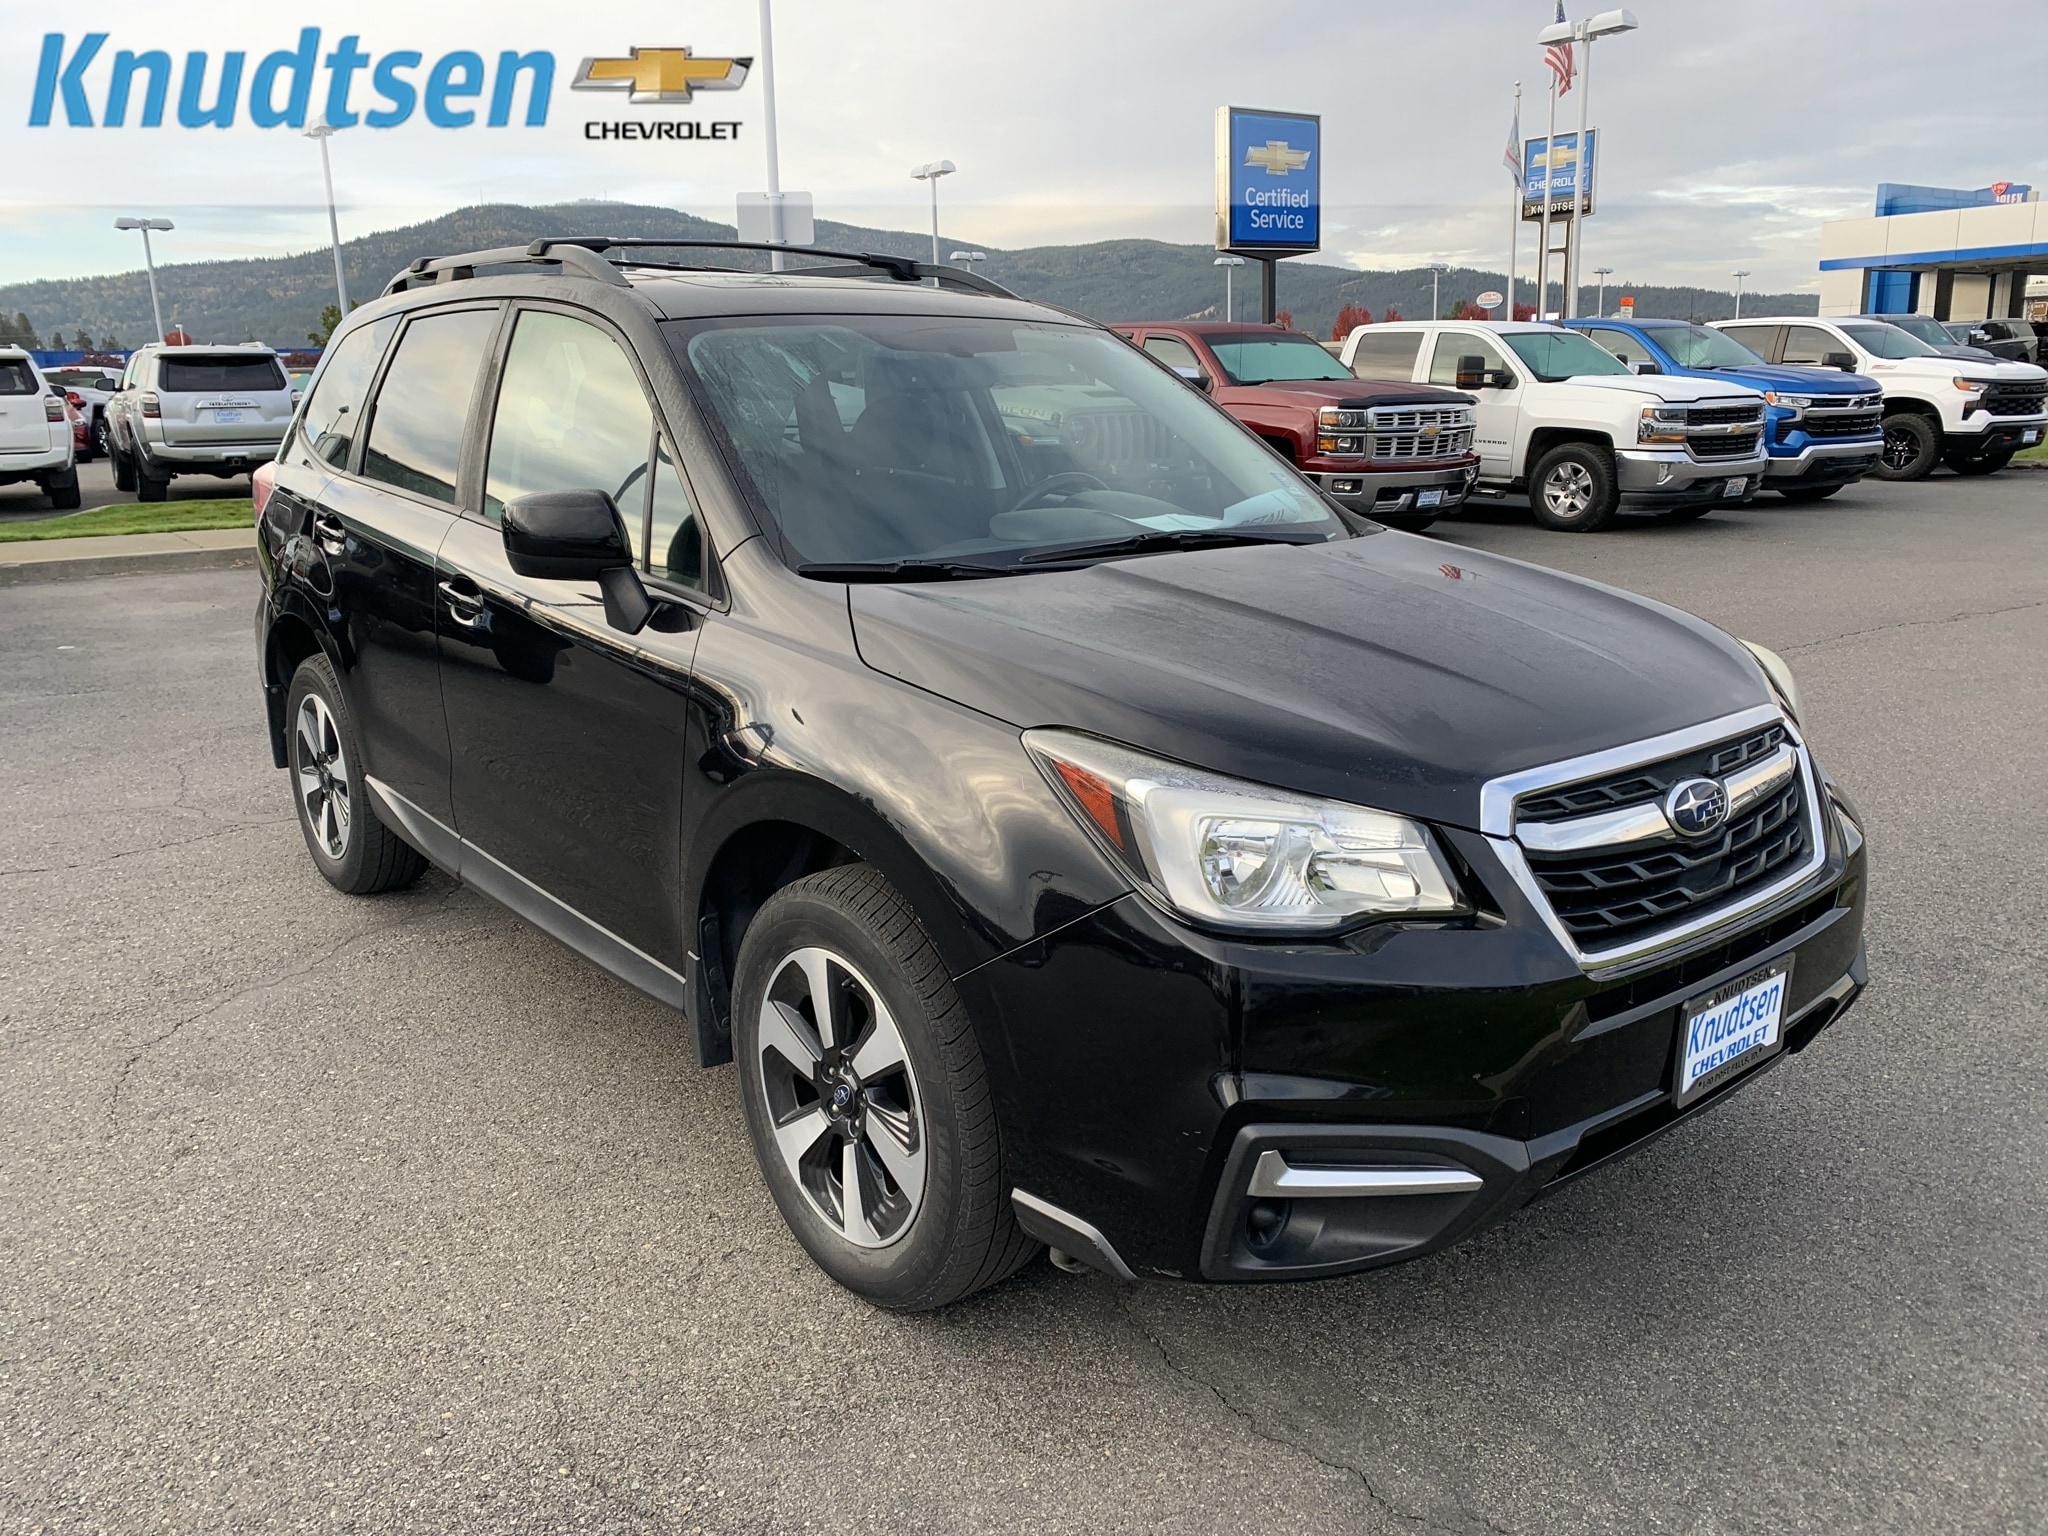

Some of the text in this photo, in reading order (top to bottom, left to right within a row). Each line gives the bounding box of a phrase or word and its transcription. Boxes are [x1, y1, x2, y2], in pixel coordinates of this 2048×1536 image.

[1528, 174, 1587, 191] CHEROL
[1245, 187, 1309, 208] Certified
[1531, 201, 1580, 215] KNDTSE
[1250, 209, 1304, 229] Service
[998, 405, 1045, 417] BICON
[1714, 966, 1772, 1003] KNUDTSEN
[1688, 984, 1780, 1059] Knudtsen
[1691, 1023, 1770, 1079] CHEVROLET
